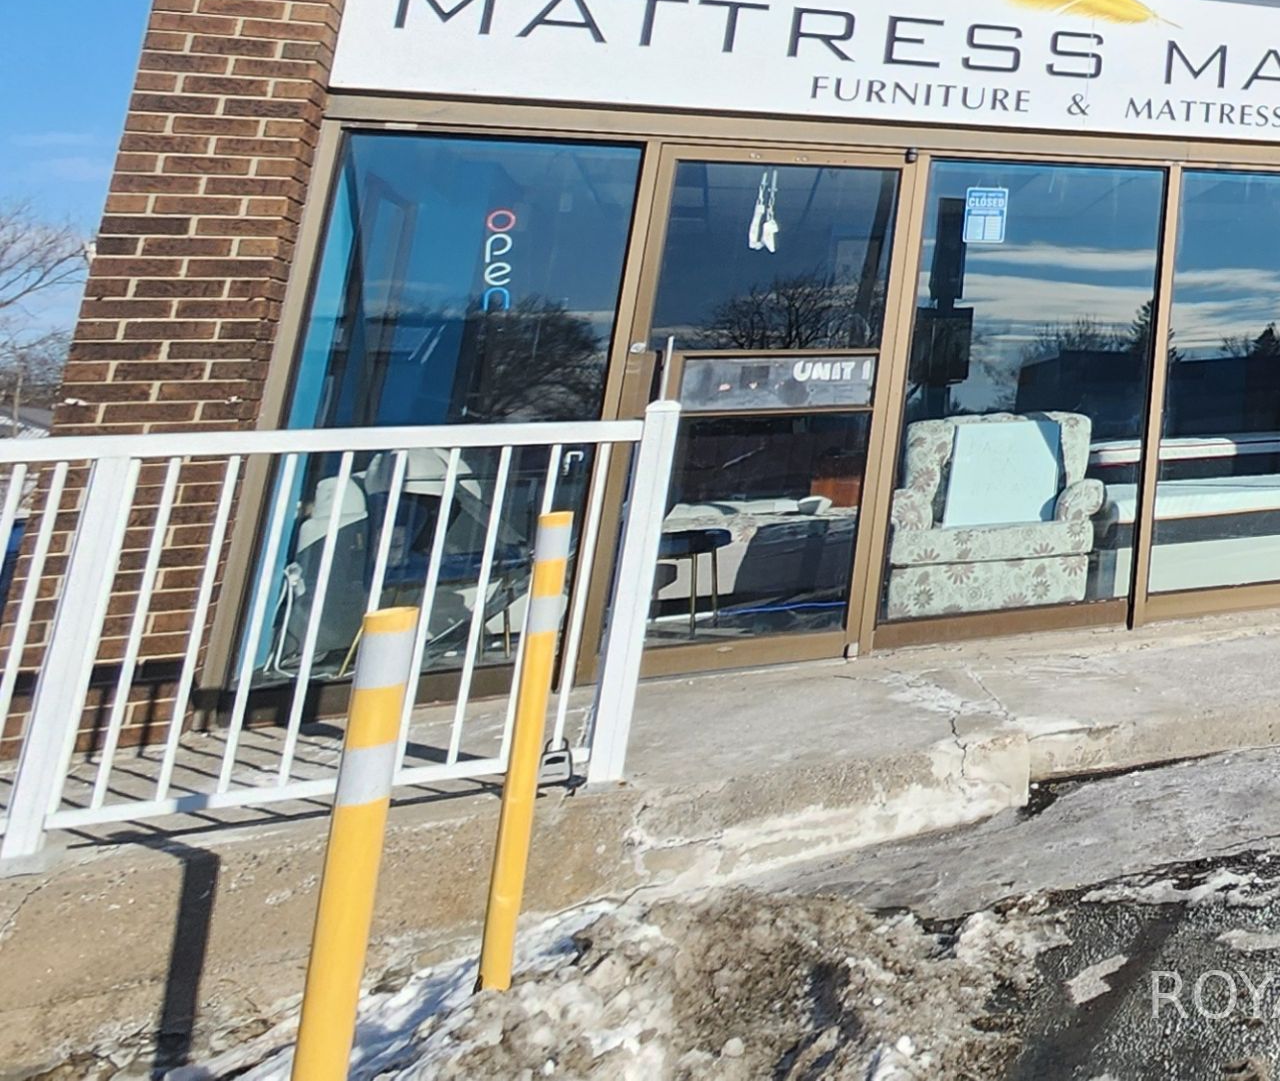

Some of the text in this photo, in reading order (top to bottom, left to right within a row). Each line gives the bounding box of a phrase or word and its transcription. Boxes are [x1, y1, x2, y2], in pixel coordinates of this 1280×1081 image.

[810, 75, 1031, 114] FURNITURE
[1067, 92, 1091, 117] &
[969, 197, 1005, 208] CLOSED
[793, 361, 855, 382] UNIT
